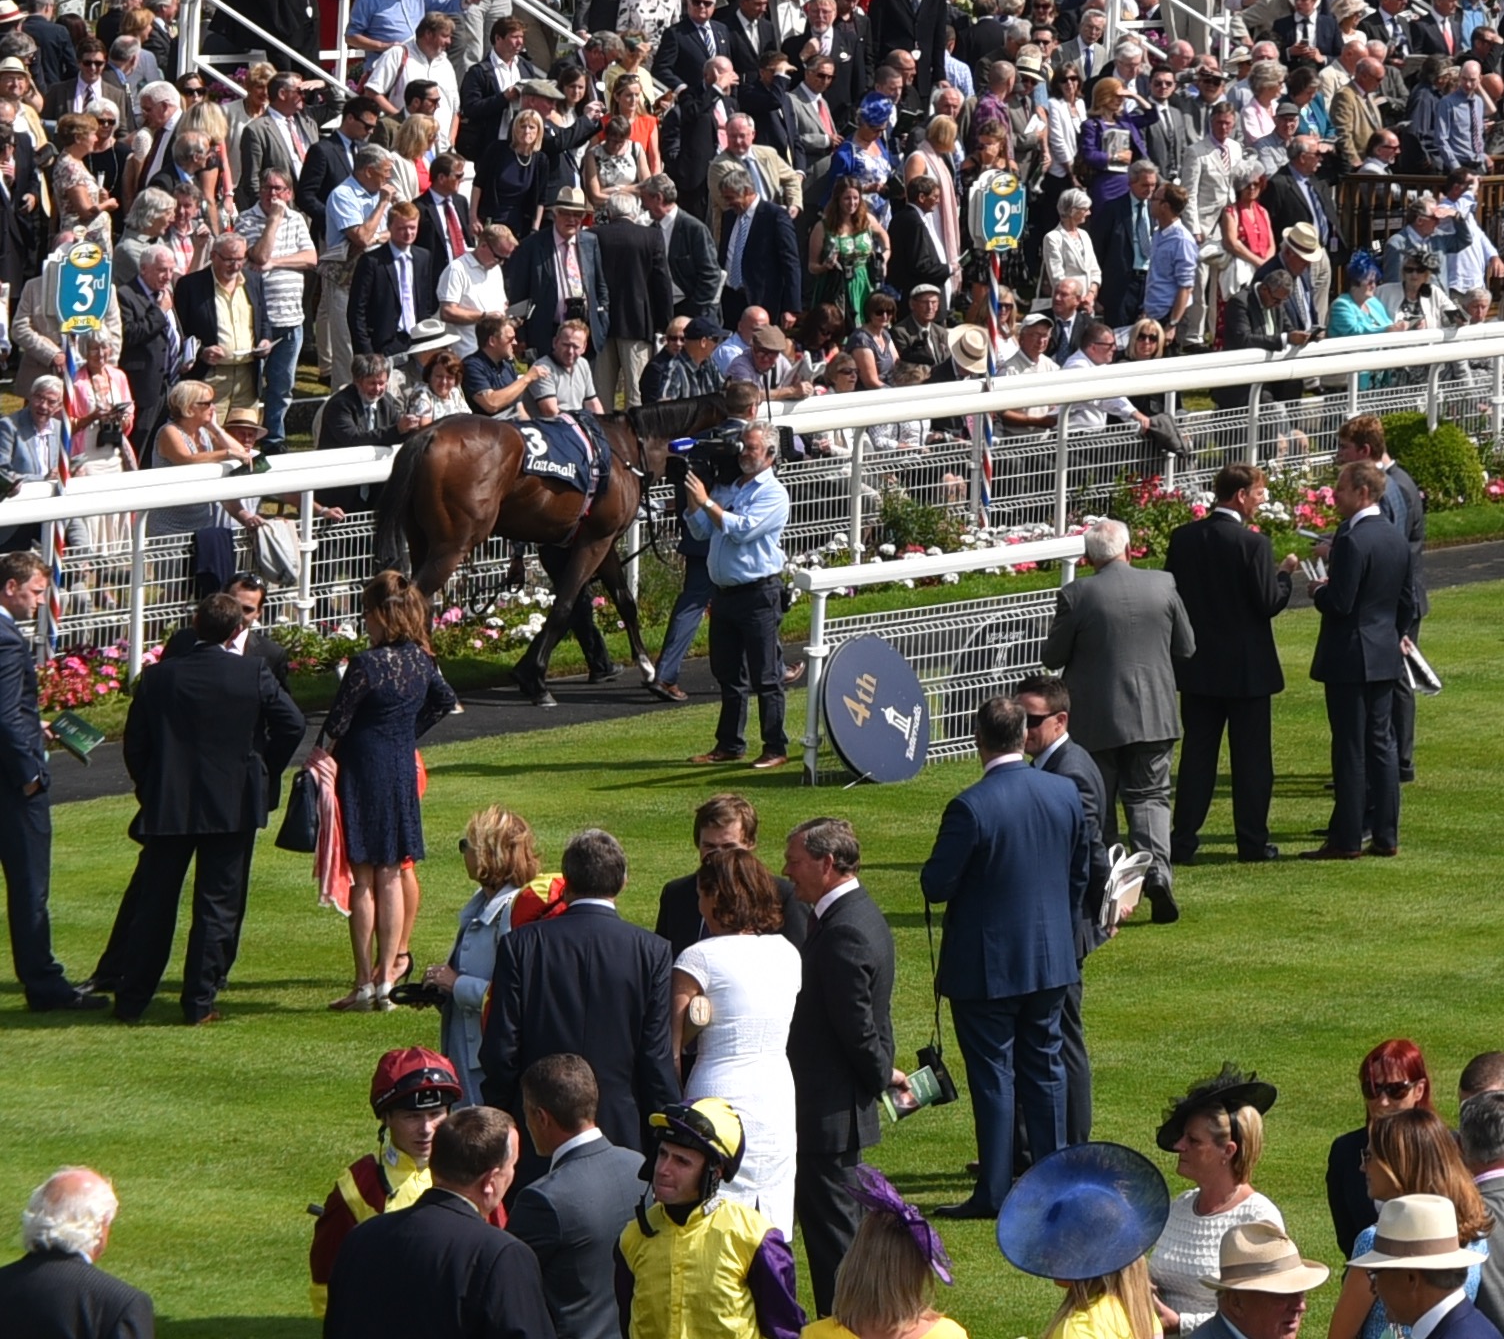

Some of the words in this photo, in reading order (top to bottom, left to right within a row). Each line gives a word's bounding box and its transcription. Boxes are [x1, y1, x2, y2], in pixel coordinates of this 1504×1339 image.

[993, 198, 1022, 234] 2nd
[71, 272, 106, 313] 3rd
[520, 426, 549, 457] 3
[842, 672, 878, 728] 4th
